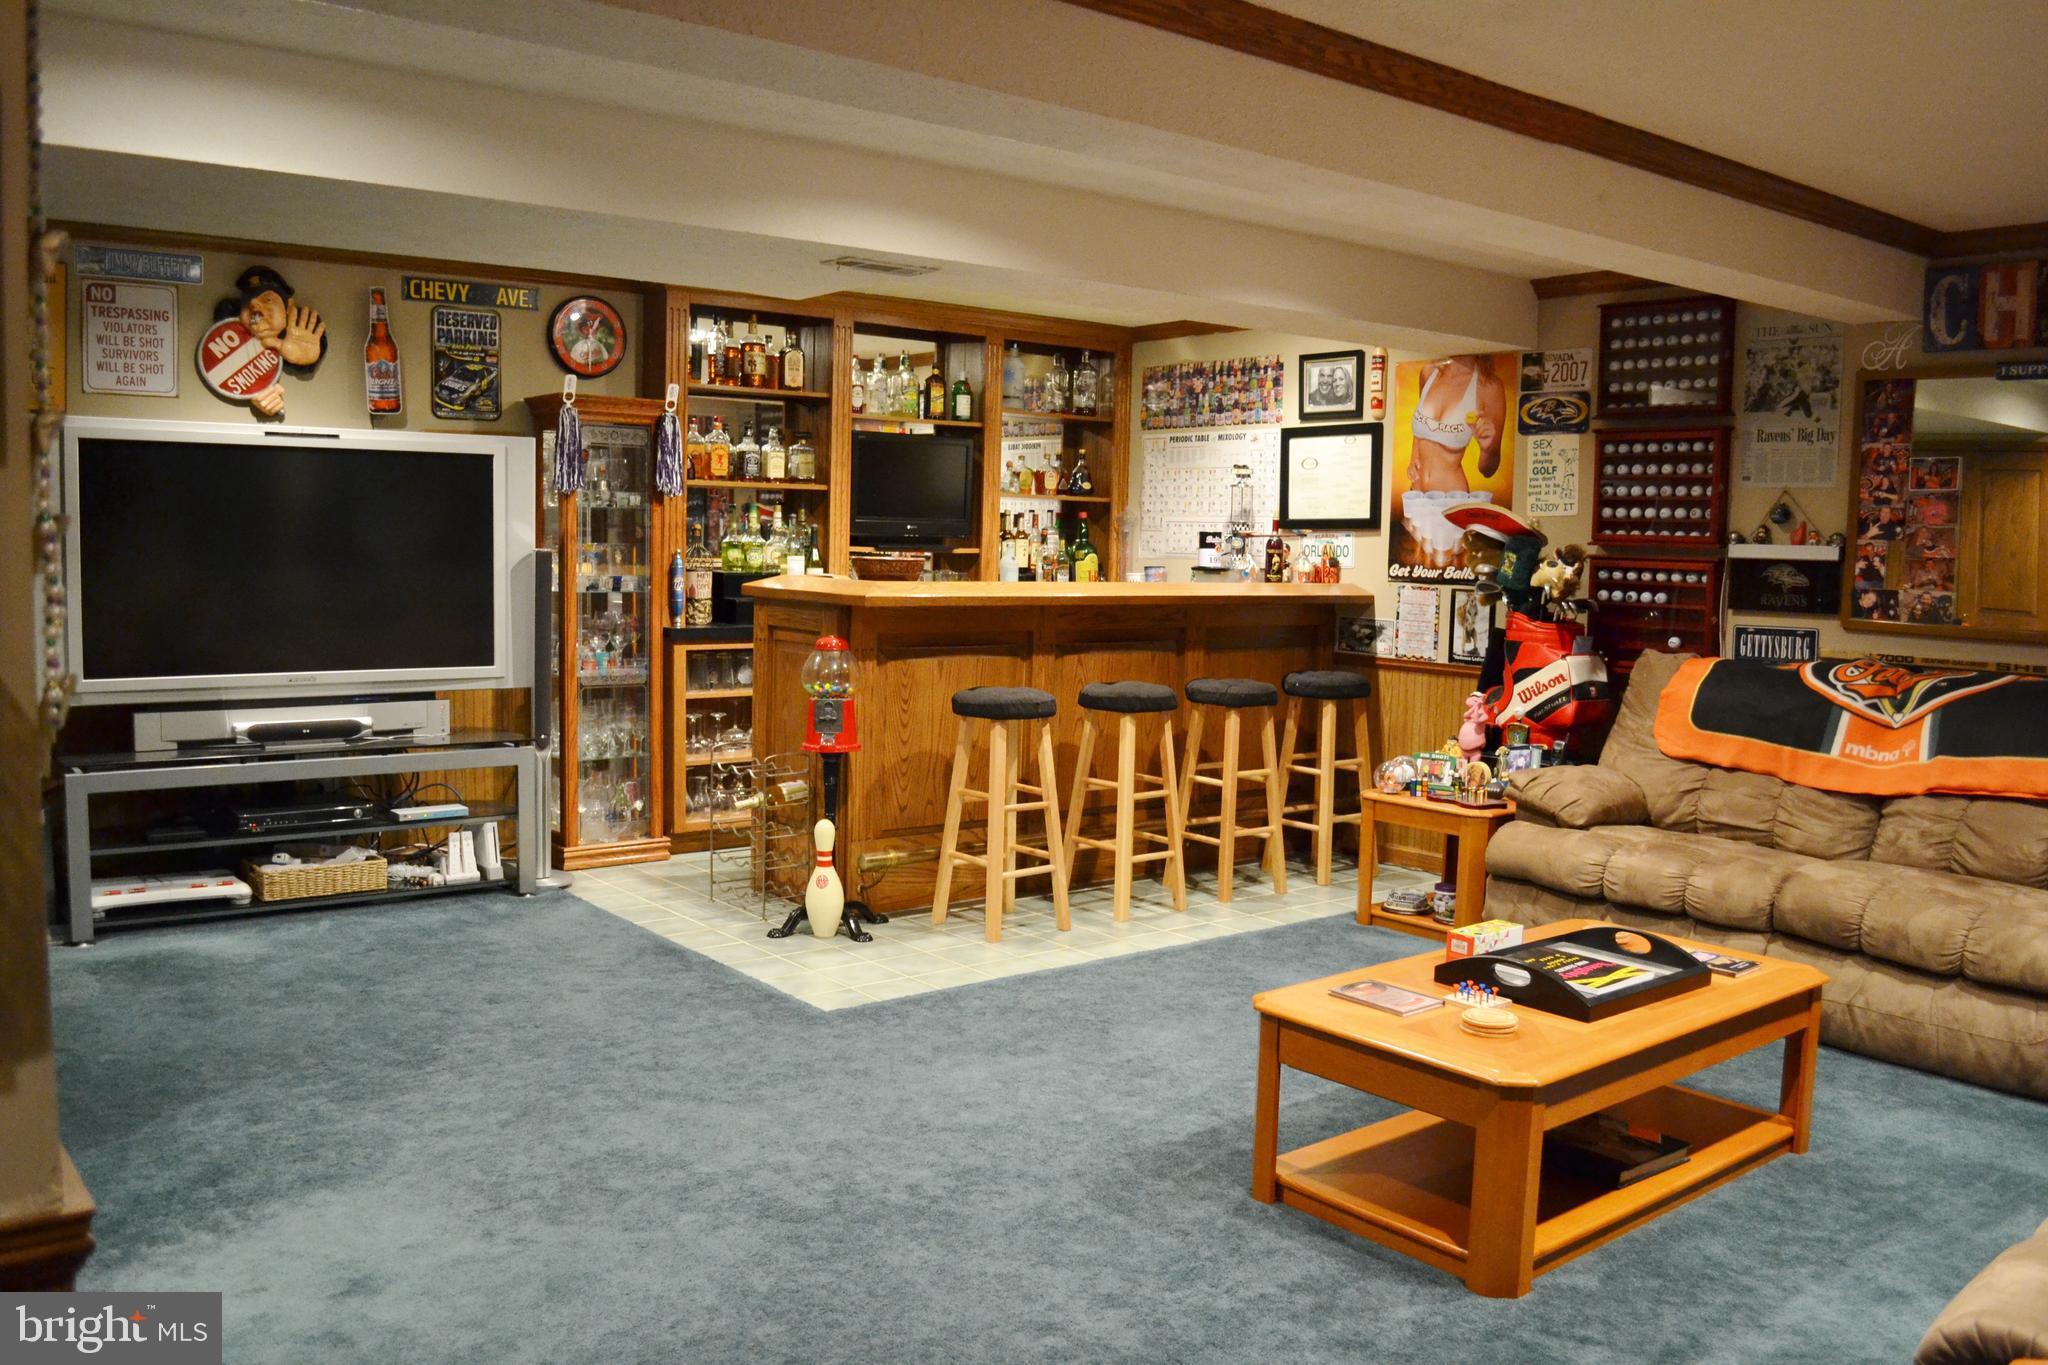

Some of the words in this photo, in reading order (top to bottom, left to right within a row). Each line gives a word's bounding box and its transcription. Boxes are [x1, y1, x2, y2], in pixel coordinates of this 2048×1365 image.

[90, 286, 113, 302] NO
[409, 279, 470, 303] CHEVY
[496, 287, 533, 308] AVE.
[90, 305, 170, 322] TRESPASSING
[436, 311, 497, 331] RESERVED
[103, 321, 158, 336] VIOLATORS
[96, 334, 120, 346] WILL
[123, 336, 136, 348] BE
[139, 337, 165, 349] SHOT
[207, 330, 241, 360] NO
[436, 328, 497, 347] PARKING
[102, 348, 159, 362] SURVIVORS
[96, 361, 120, 373] WILL
[123, 362, 137, 374] BE
[139, 363, 165, 375] SHOT
[227, 349, 278, 395] SMOKING
[1550, 360, 1588, 383] 2007
[2009, 364, 2048, 375] SUPP
[115, 375, 147, 387] AGAIN
[1169, 435, 1193, 444] PERIODIC
[1194, 434, 1210, 442] TABLE
[1217, 433, 1247, 441] MIXOLOGY
[1533, 439, 1553, 449] SEX
[1797, 427, 1815, 445] Big
[1816, 427, 1835, 445] Day
[1532, 466, 1558, 475] GOLF
[1530, 503, 1559, 512] ENJOY
[1563, 503, 1575, 512] IT
[1303, 544, 1350, 558] ORLANDO
[1389, 563, 1411, 577] Get
[1411, 565, 1443, 579] Your
[1443, 566, 1475, 580] Balls
[1739, 633, 1810, 660] GETTYSBURG
[1517, 673, 1568, 704] Wilson
[1844, 742, 1900, 762] mbna
